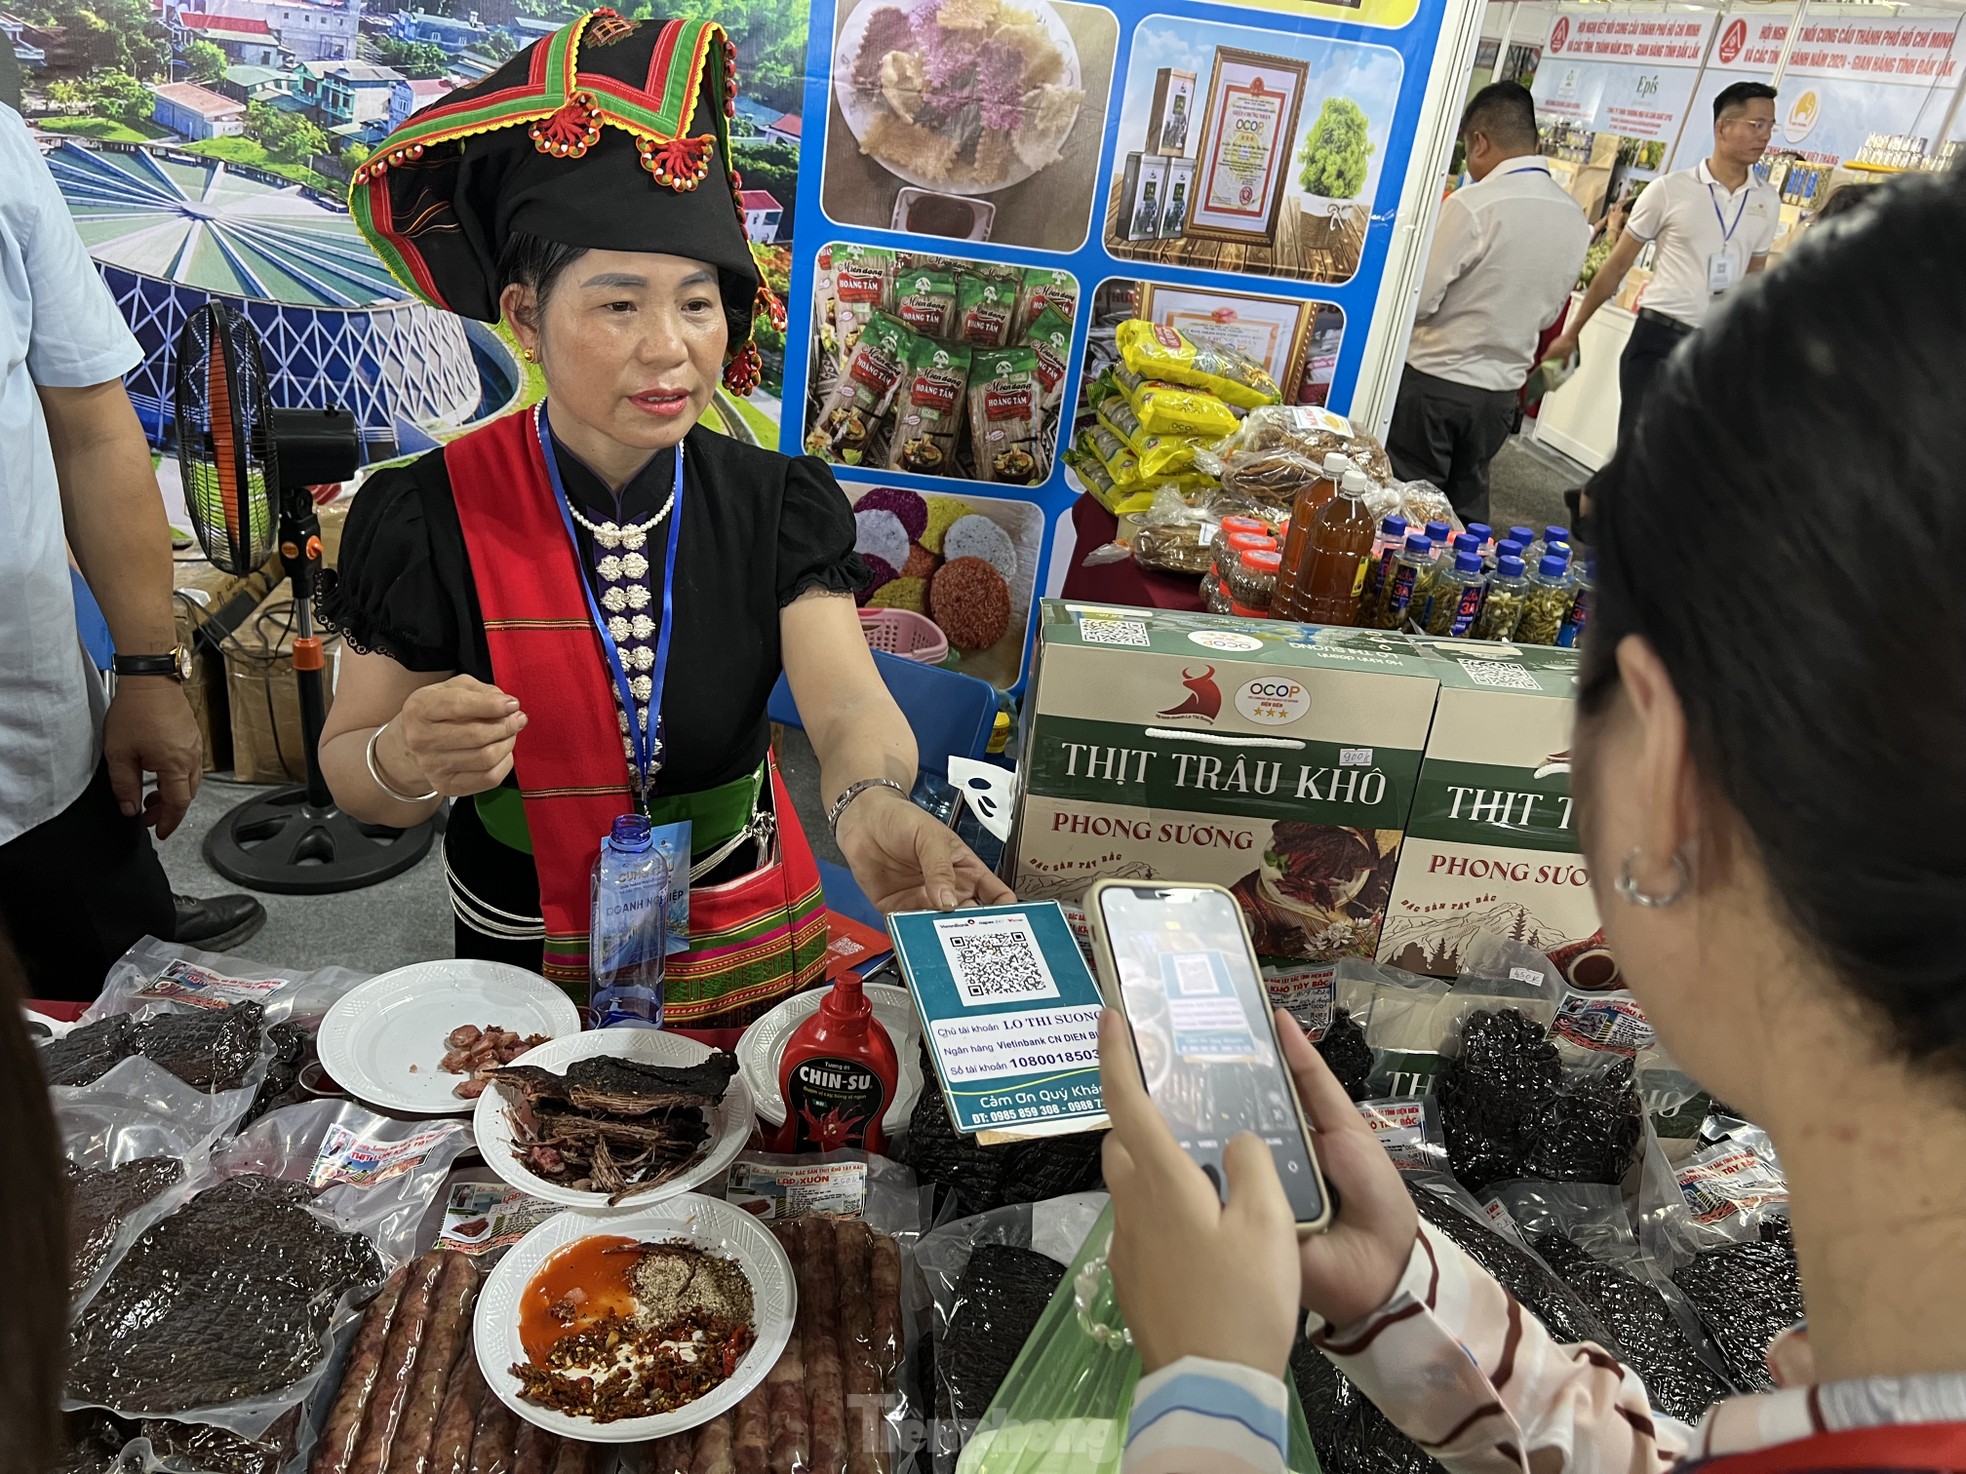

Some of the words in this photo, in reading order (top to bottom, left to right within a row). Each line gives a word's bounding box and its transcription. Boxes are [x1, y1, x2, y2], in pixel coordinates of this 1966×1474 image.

[1816, 27, 1840, 43] CUNG
[1235, 118, 1265, 132] OCOP
[1250, 682, 1301, 698] OCOP
[1061, 742, 1158, 786] THỊT
[1171, 752, 1283, 796] TRÂU
[1293, 766, 1388, 807] KHÔ
[1051, 811, 1152, 841] PHONG
[1158, 823, 1254, 850] SƯƠNG
[1427, 853, 1530, 882] PHONG
[605, 899, 644, 917] DOANH
[937, 1026, 957, 1038] Chủ
[959, 1023, 972, 1035] tài
[971, 1022, 1000, 1034] khoản
[1003, 1019, 1023, 1031] LO
[1025, 1015, 1053, 1028] THI
[943, 1047, 969, 1057] Ngân
[971, 1043, 995, 1055] hàng
[996, 1036, 1047, 1050] Vietinbank
[1047, 1034, 1062, 1045] CN
[1063, 1032, 1088, 1043] DIEN
[799, 1065, 872, 1091] CHIN-SU
[950, 1064, 964, 1076] Số
[965, 1063, 978, 1075] tài
[979, 1061, 1008, 1073] khoản
[980, 1095, 1013, 1109] Cảm
[1015, 1091, 1037, 1104] Ơn
[1039, 1087, 1069, 1102] Quý
[990, 1108, 1017, 1123] 0985
[1018, 1106, 1039, 1119] 859
[1040, 1103, 1060, 1116] 308
[1068, 1100, 1094, 1113] 0988
